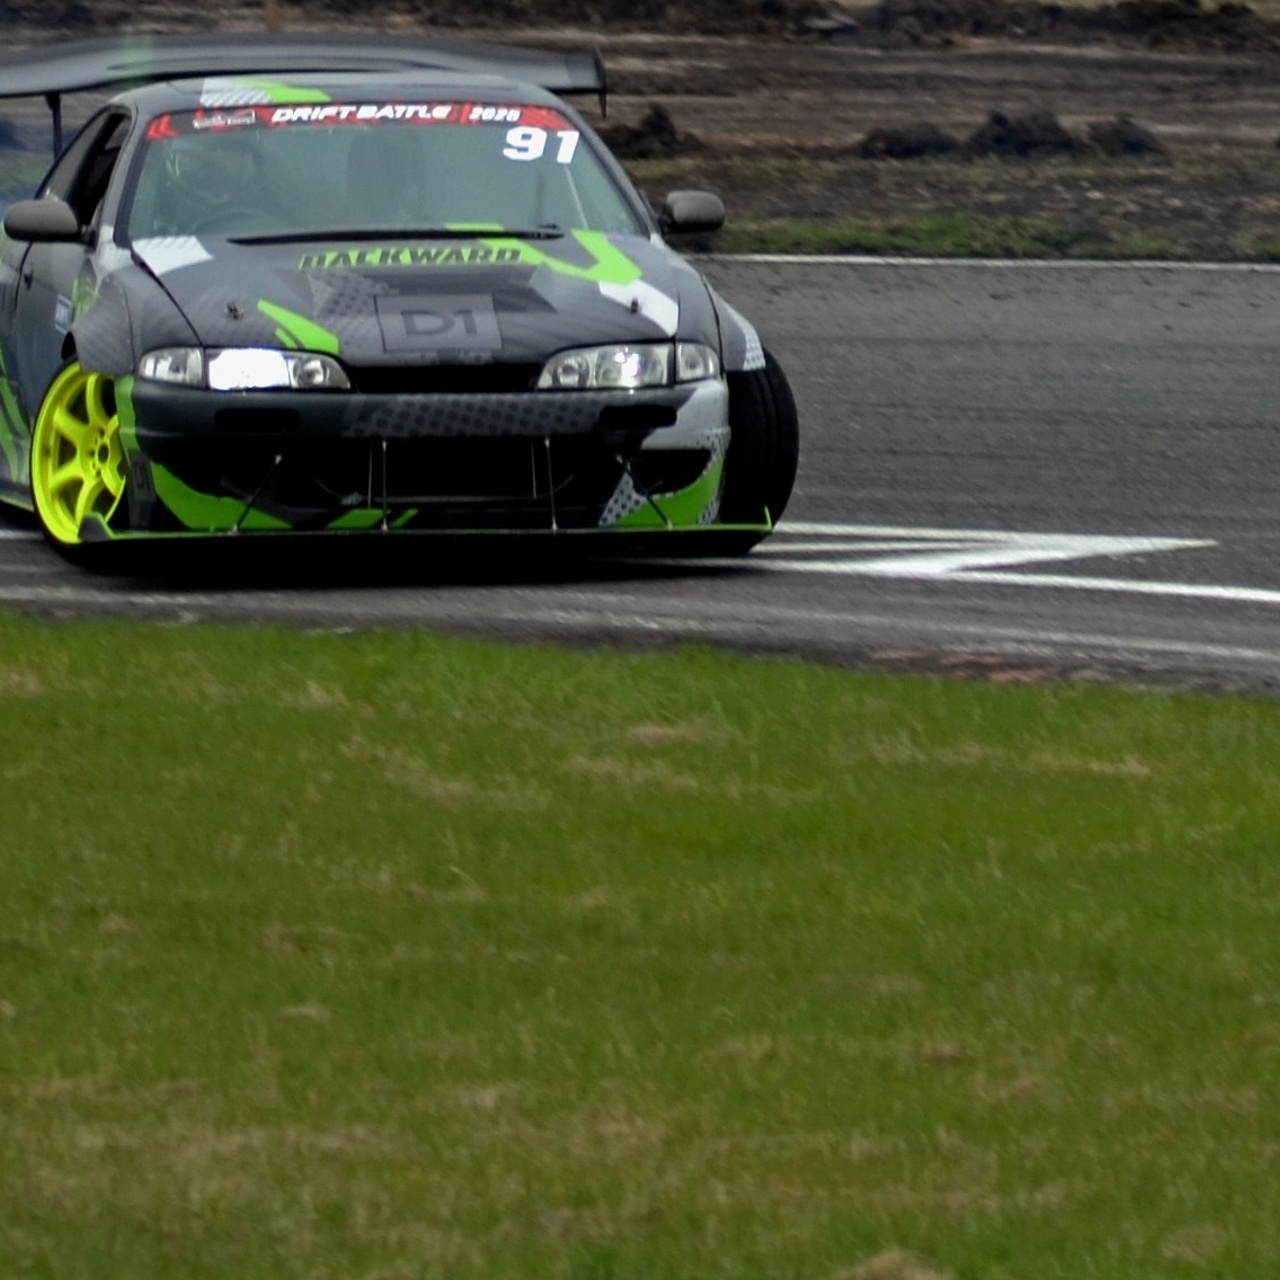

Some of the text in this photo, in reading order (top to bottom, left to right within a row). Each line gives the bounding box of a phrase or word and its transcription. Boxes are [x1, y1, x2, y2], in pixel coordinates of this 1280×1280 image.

[271, 105, 356, 123] DRIFT
[356, 104, 453, 120] BATTLE
[503, 126, 579, 163] 91
[300, 247, 522, 269] BACKWARD
[401, 308, 478, 335] D1
